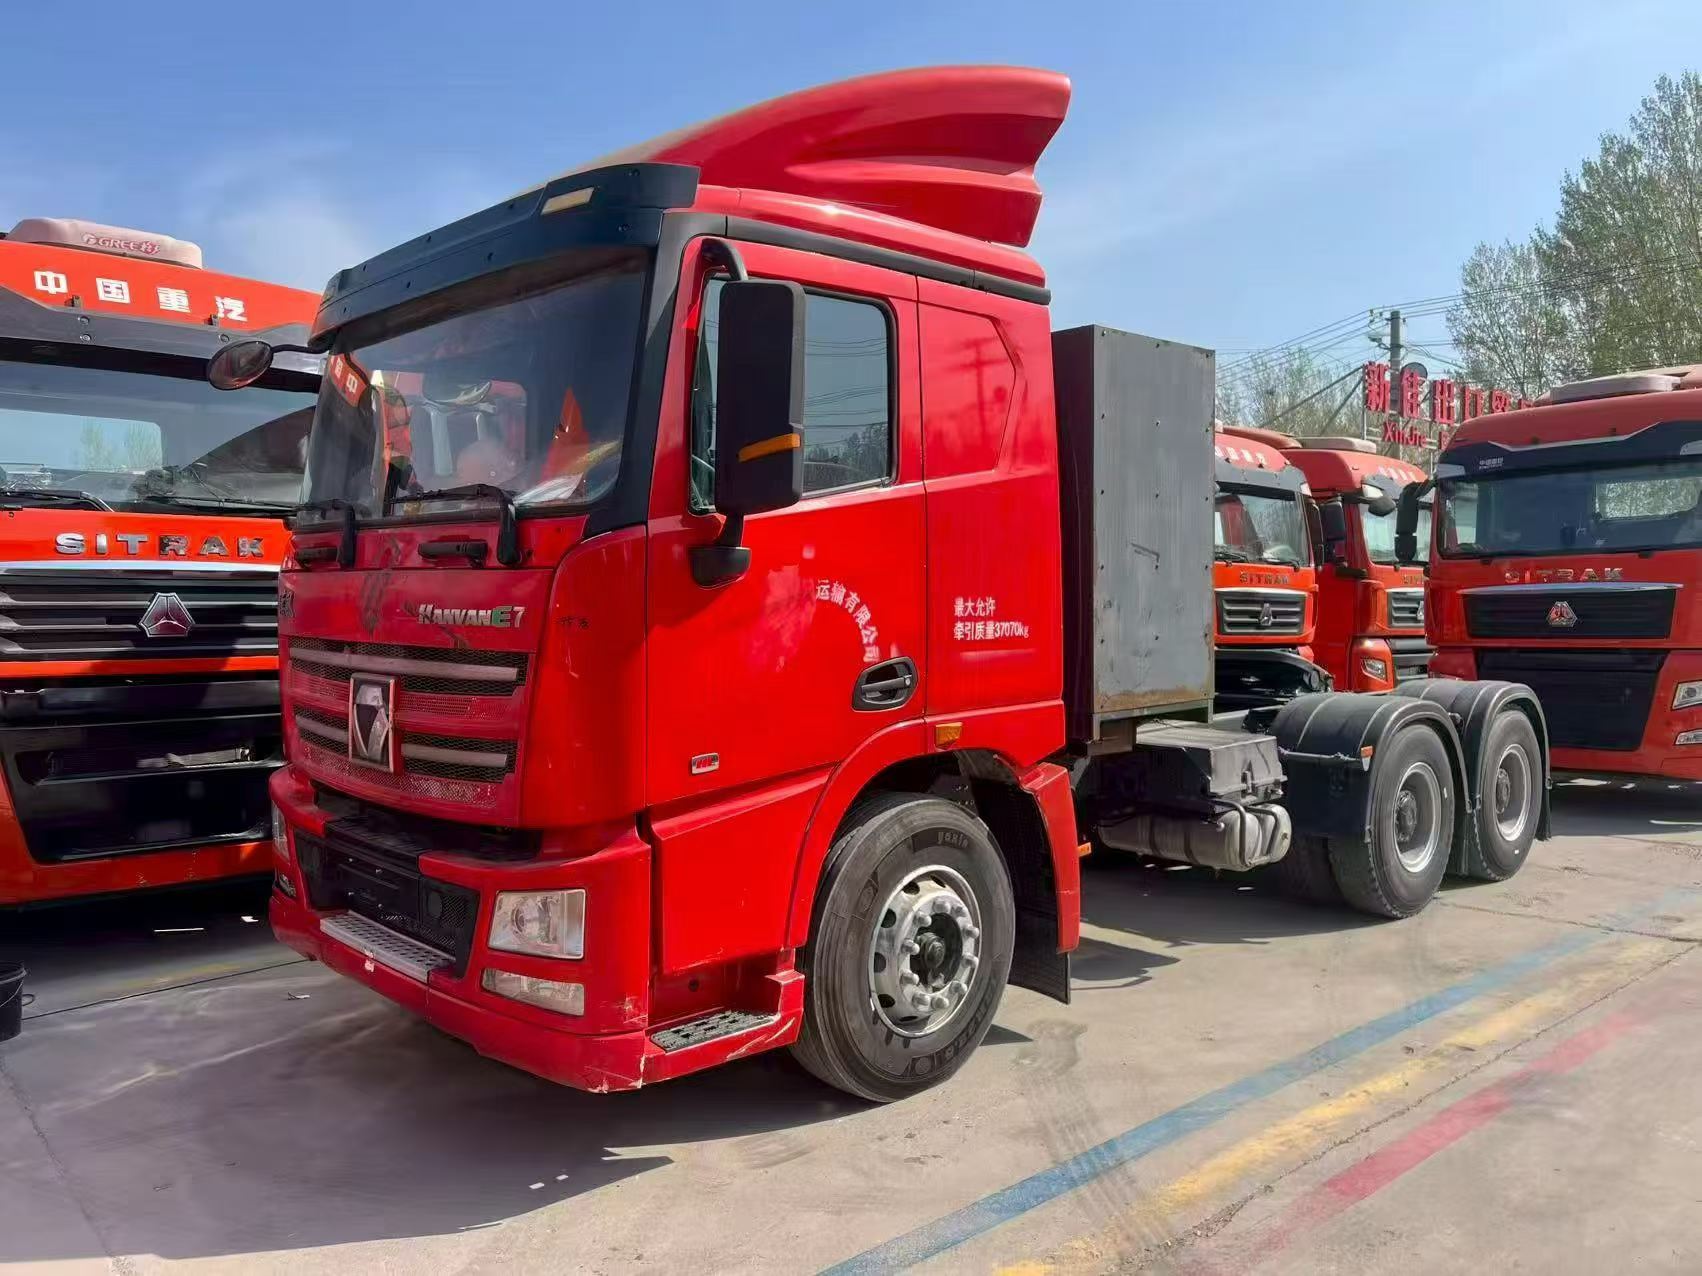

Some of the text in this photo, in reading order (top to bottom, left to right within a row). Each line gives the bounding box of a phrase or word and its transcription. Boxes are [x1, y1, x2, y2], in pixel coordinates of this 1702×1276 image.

[98, 237, 139, 250] GREE
[34, 270, 248, 322] 中国重汽
[55, 532, 265, 557] SITRAK
[1505, 567, 1623, 583] SITRAK
[954, 597, 996, 617] 最大允许
[815, 579, 880, 663] 运输有限公司
[954, 621, 1029, 641] 牵引质量37070kg
